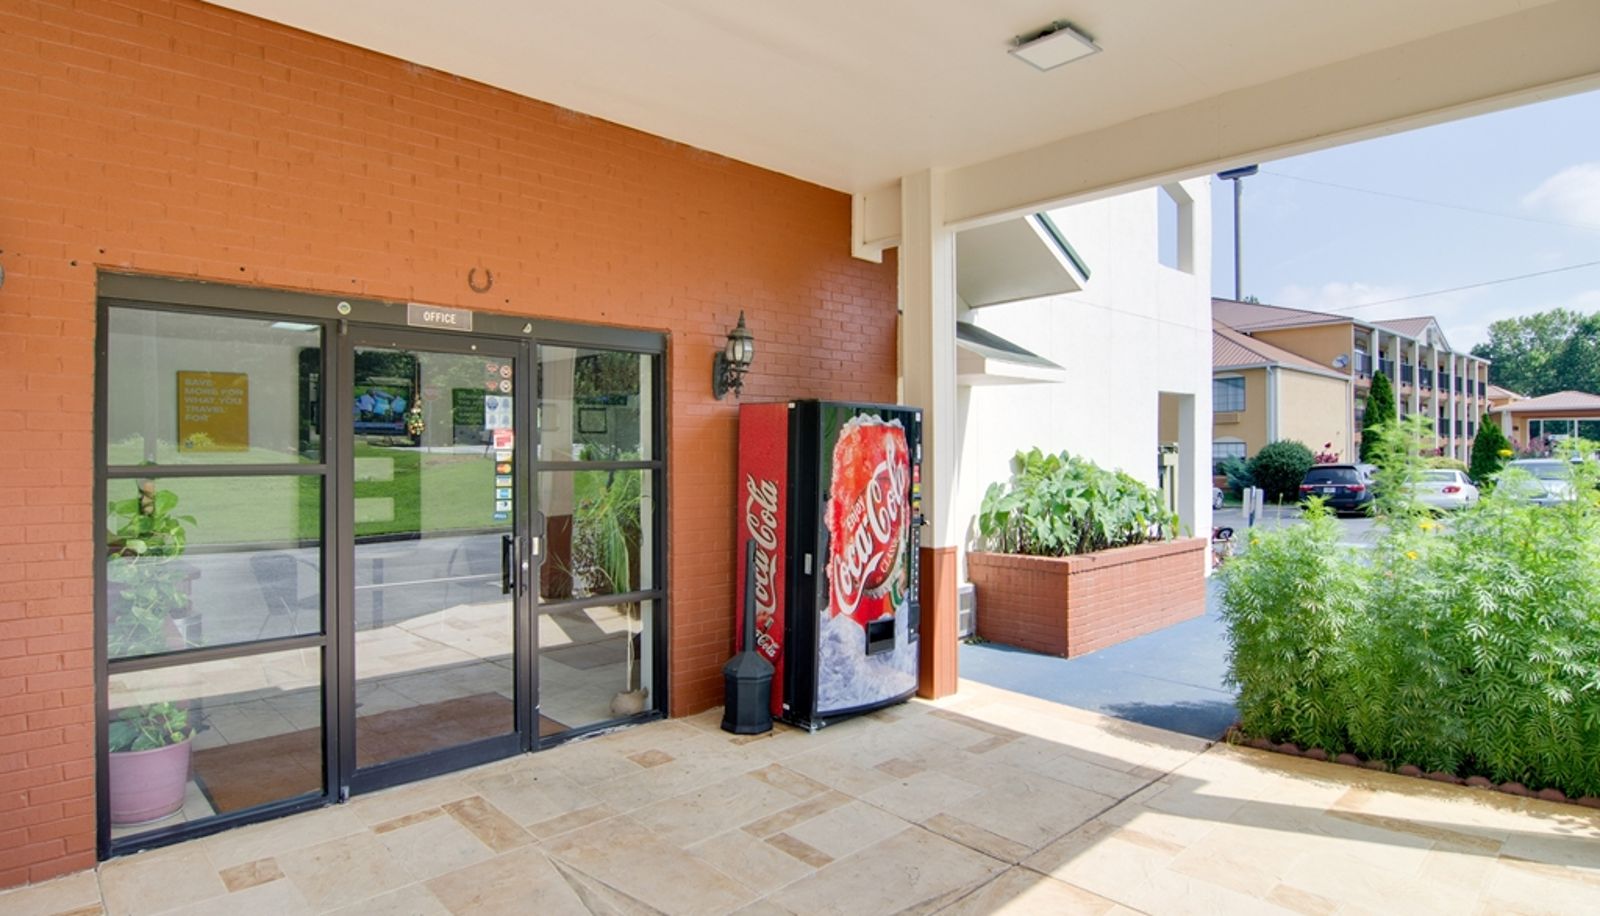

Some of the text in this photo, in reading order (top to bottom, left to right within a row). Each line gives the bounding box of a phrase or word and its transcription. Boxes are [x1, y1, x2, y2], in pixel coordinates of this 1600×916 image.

[423, 311, 457, 324] OFFICE
[184, 387, 243, 396] MORE FOR
